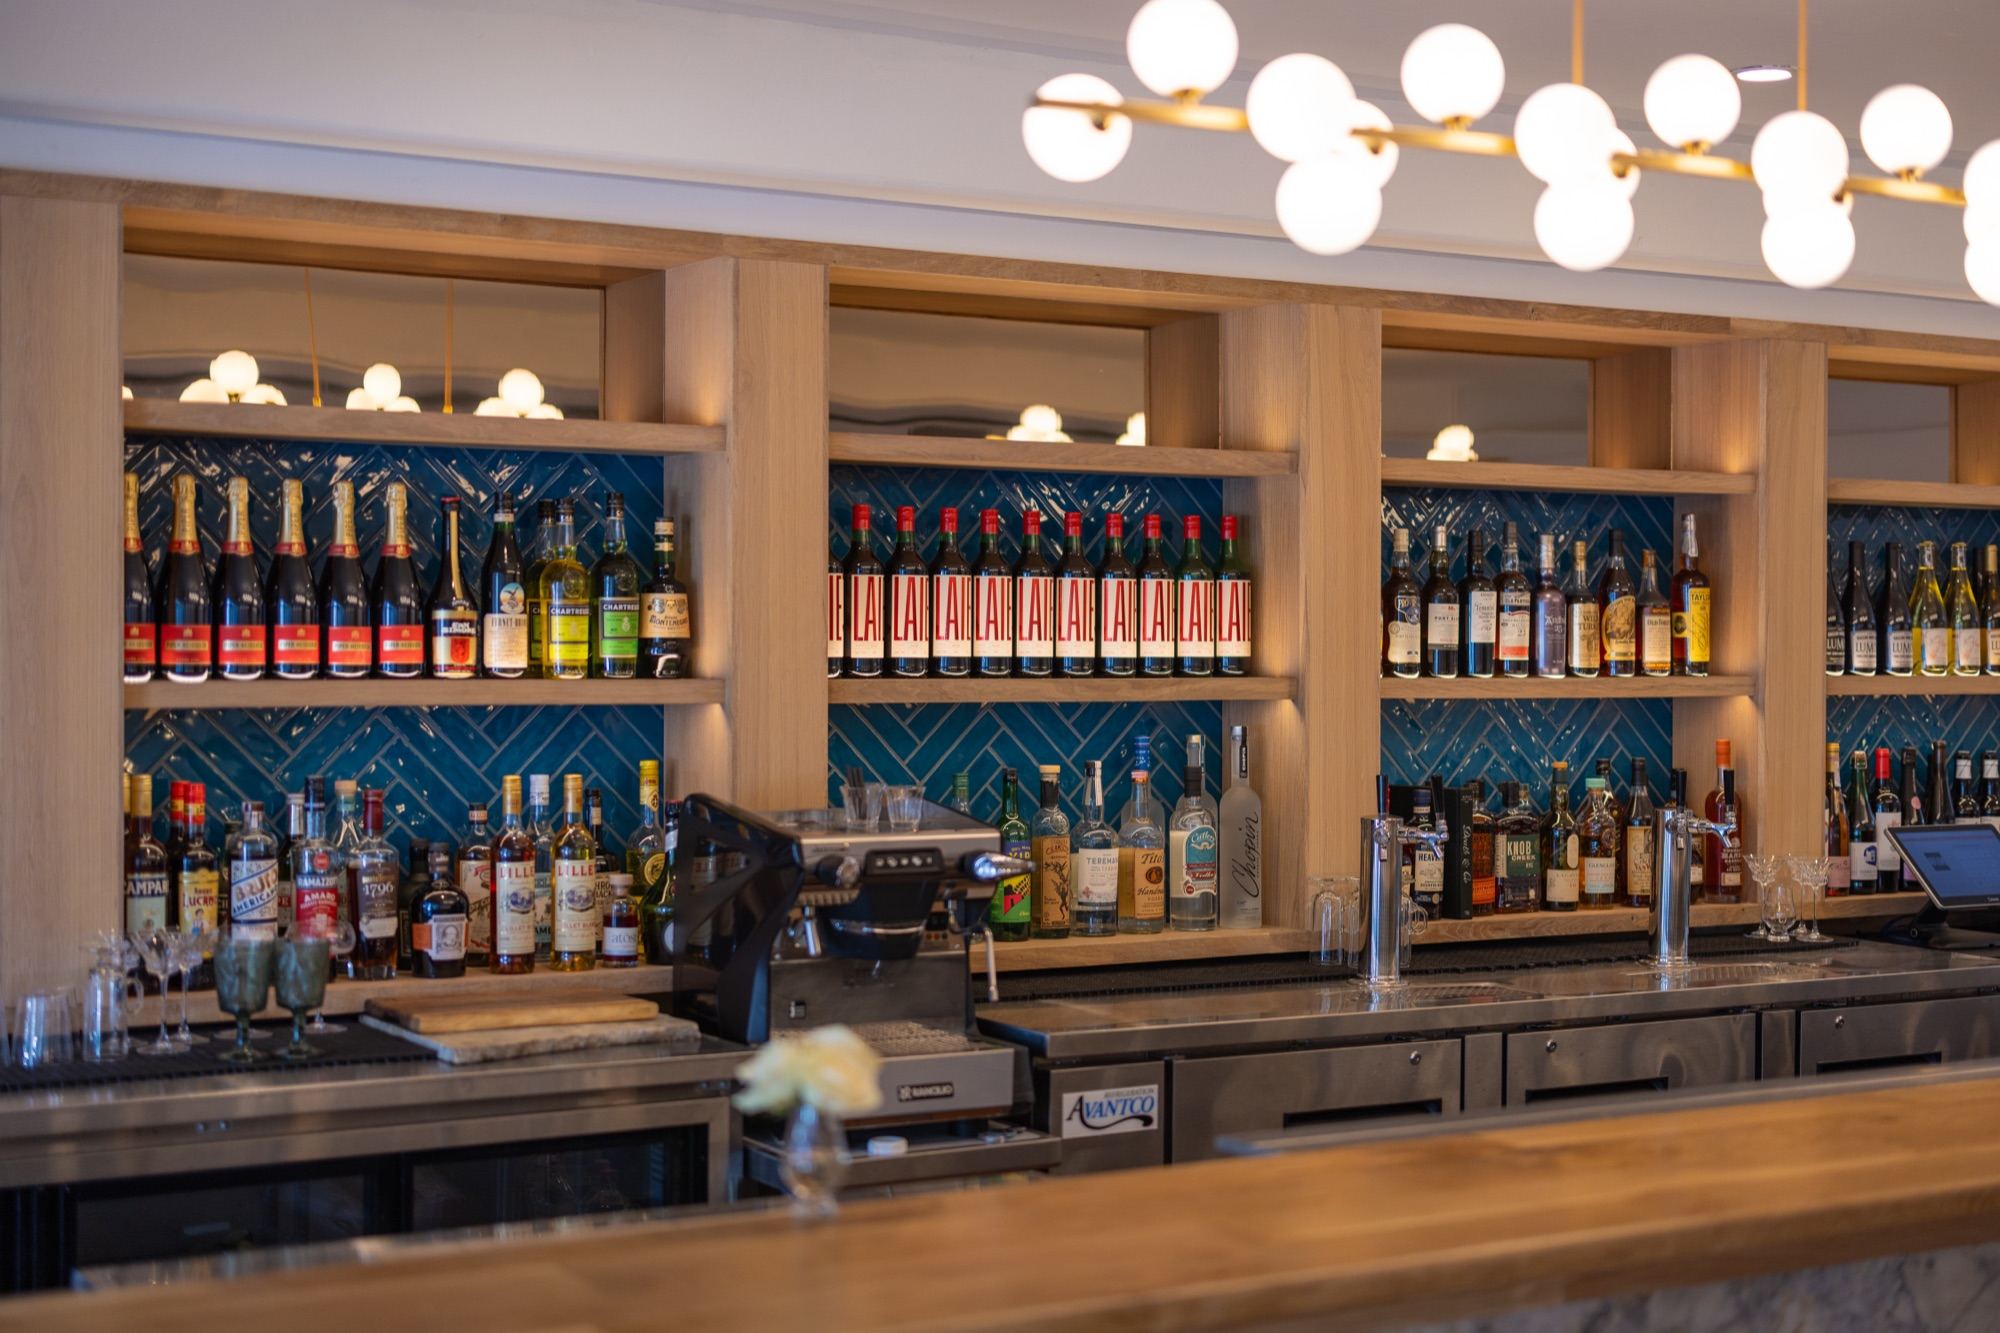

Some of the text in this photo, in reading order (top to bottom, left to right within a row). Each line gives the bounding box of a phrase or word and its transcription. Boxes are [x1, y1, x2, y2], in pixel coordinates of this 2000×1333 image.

[1231, 812, 1261, 898] Chopin
[1507, 841, 1531, 856] KNOB
[364, 881, 394, 898] 1796
[1066, 1094, 1155, 1129] AVANTCO
